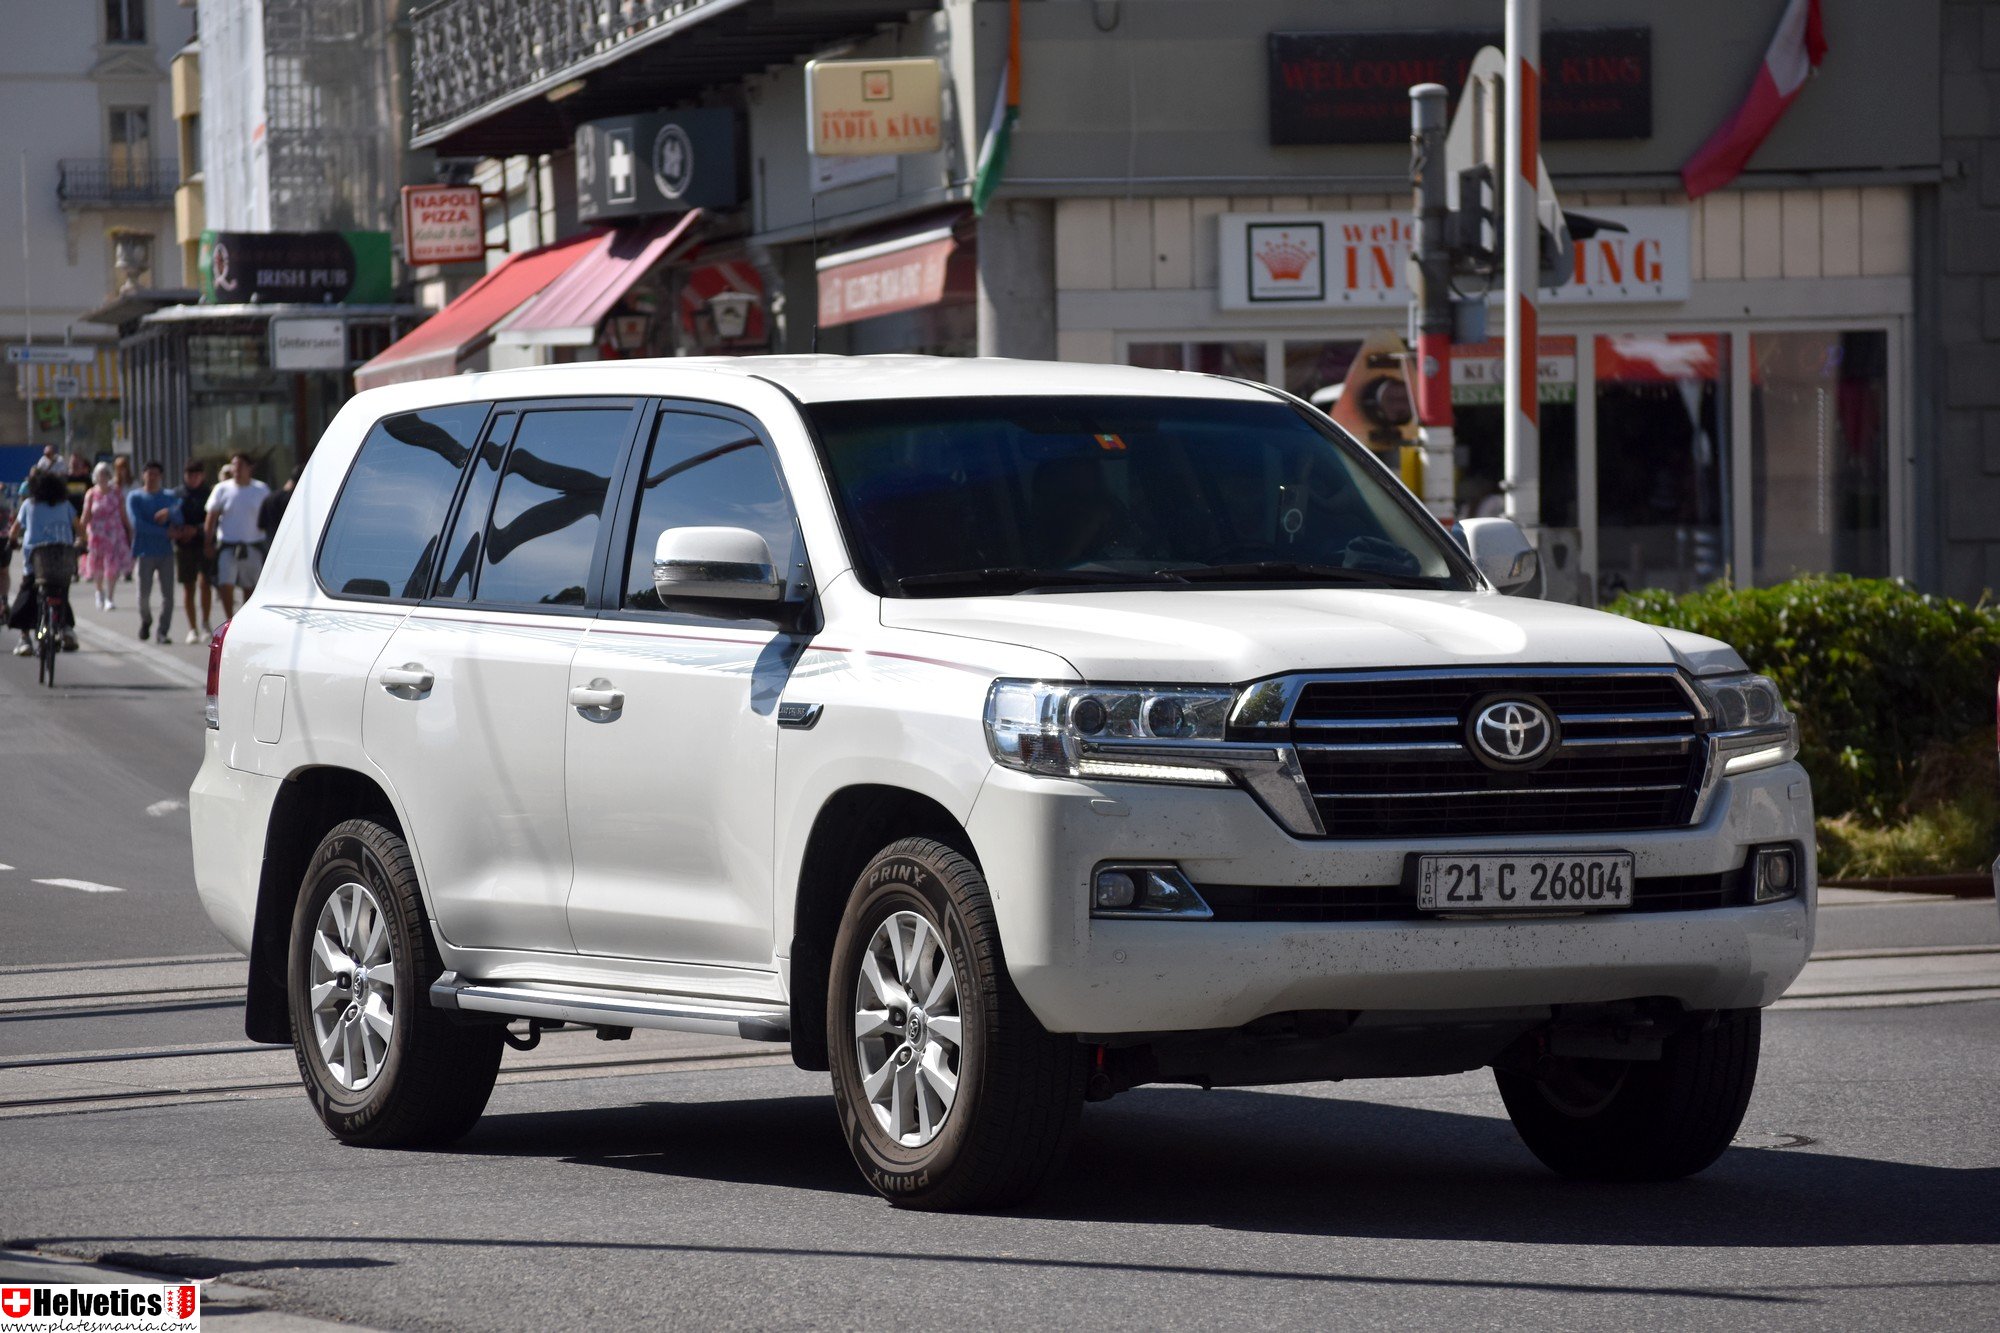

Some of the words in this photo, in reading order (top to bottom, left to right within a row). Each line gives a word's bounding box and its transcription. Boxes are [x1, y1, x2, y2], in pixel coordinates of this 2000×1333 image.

[1562, 56, 1643, 86] KING
[822, 119, 878, 139] INDIA
[886, 113, 937, 137] KING
[414, 193, 476, 208] NAPOLI
[422, 209, 470, 223] PIZZA
[1573, 239, 1663, 286] ING
[256, 269, 306, 287] IRISH
[310, 269, 348, 287] PUB
[869, 864, 927, 889] PRINX
[1446, 863, 1483, 902] 21
[1498, 863, 1517, 901] C
[1530, 862, 1623, 901] 26804
[871, 1168, 929, 1192] PRINX
